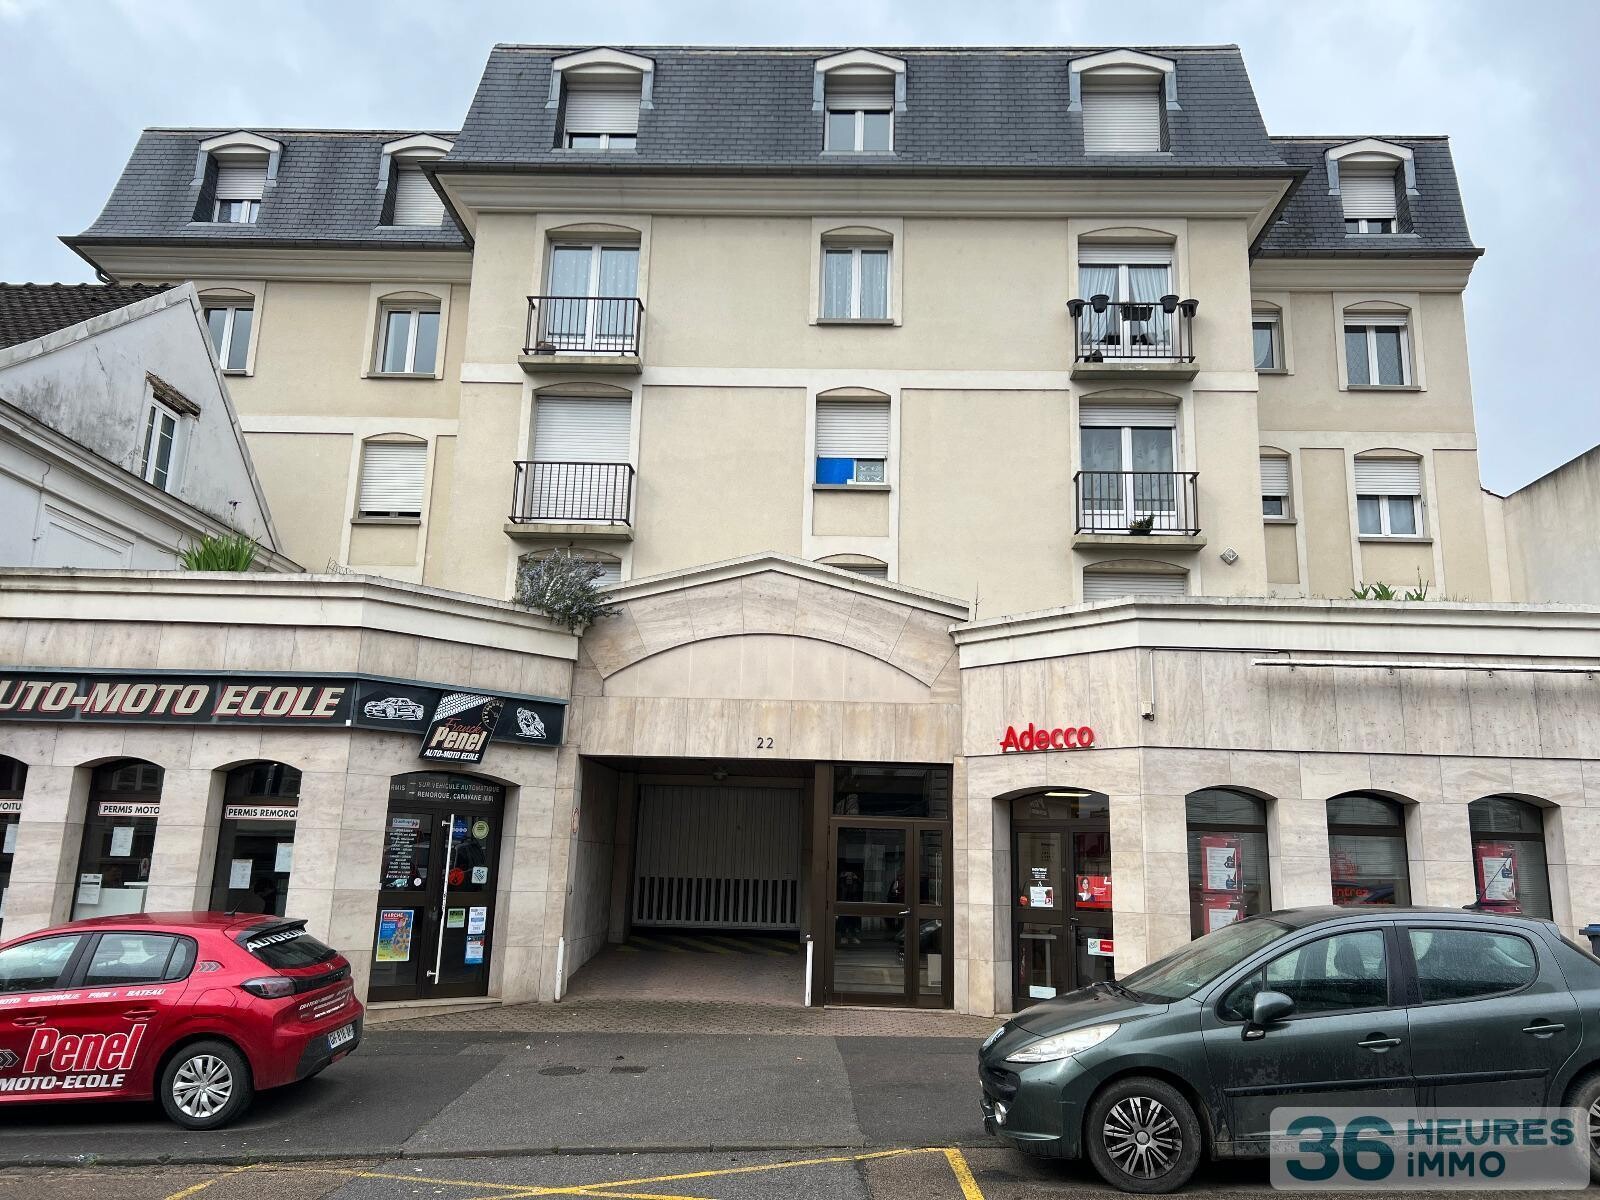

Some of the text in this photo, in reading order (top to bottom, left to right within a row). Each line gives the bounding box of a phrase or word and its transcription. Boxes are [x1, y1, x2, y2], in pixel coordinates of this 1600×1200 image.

[212, 685, 345, 717] ECOLE
[429, 726, 488, 751] Penel
[756, 736, 774, 749] 22
[1000, 722, 1094, 752] Adecco
[424, 749, 480, 760] AUTO-MOTO ECOLE
[103, 805, 133, 813] PERMIS
[228, 808, 258, 817] PERMIS
[22, 1023, 147, 1073] Penel
